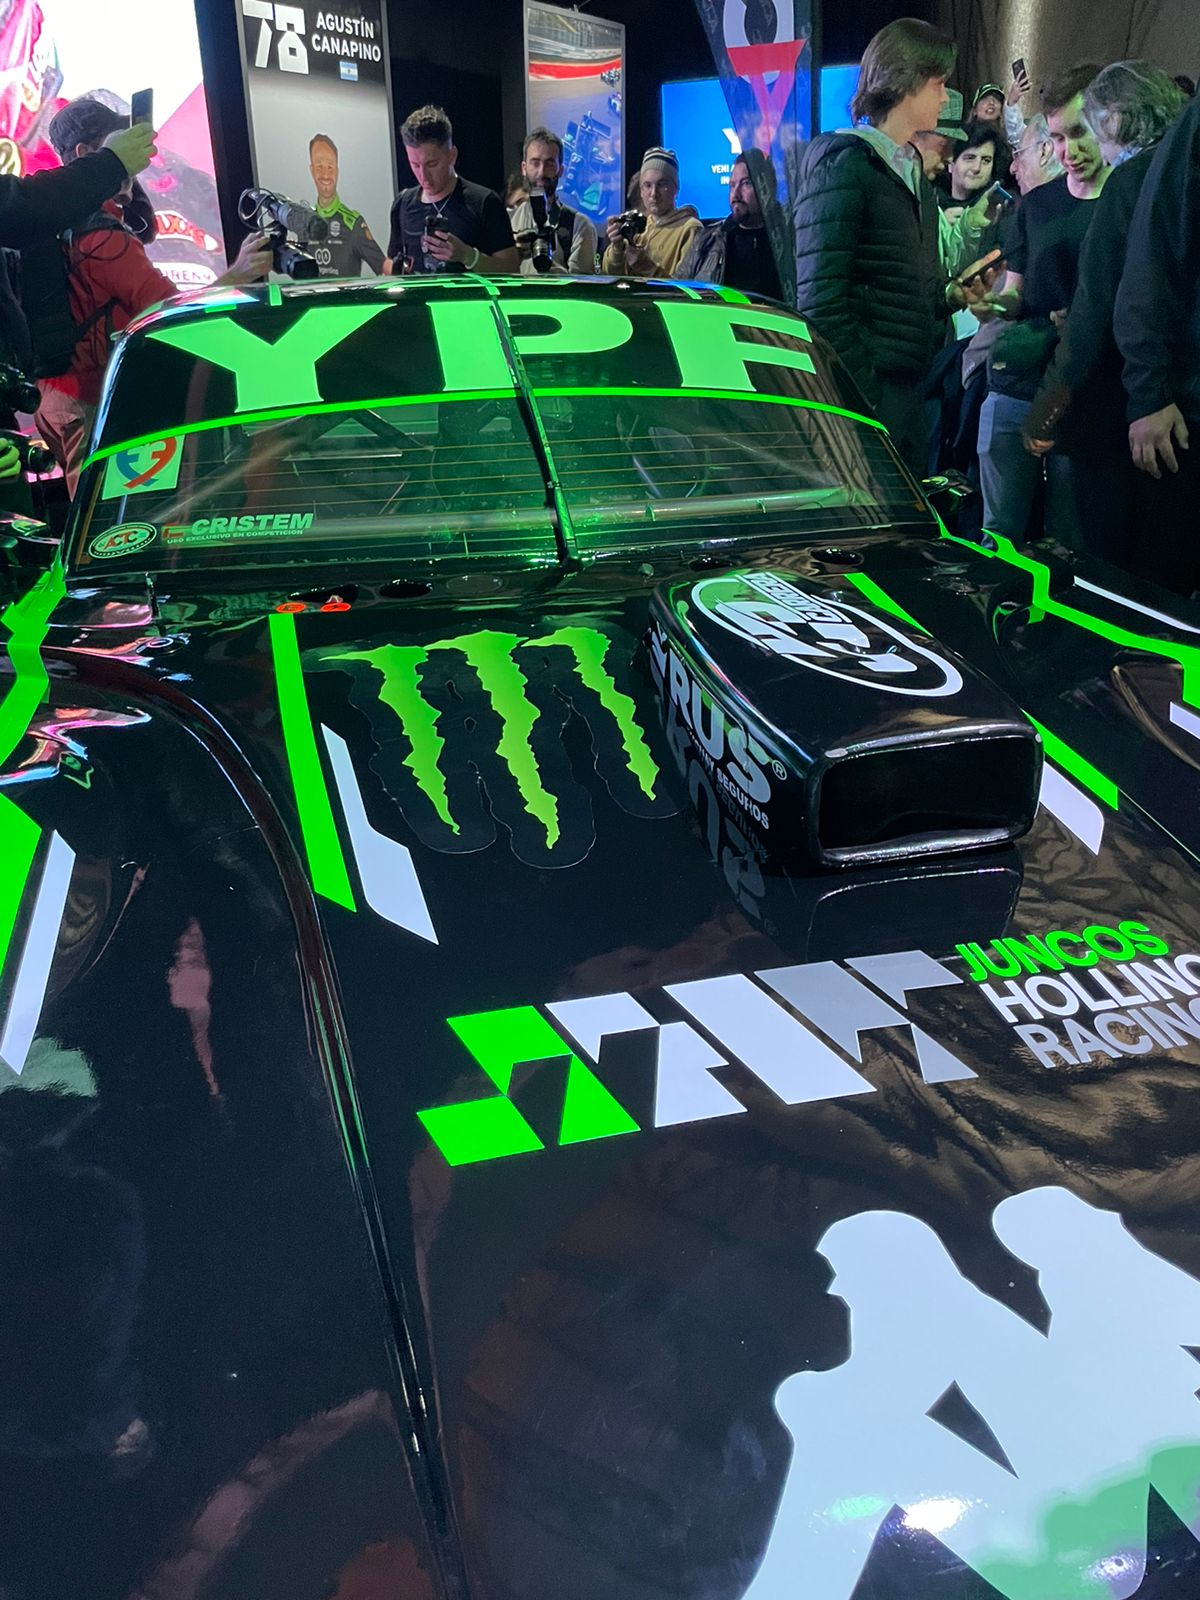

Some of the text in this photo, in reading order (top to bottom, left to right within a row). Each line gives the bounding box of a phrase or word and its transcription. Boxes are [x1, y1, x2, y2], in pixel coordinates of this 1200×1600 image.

[242, 0, 309, 74] 78
[311, 34, 382, 62] CANAPINO
[316, 11, 375, 39] AGUSTÍN
[145, 300, 817, 413] YPF
[186, 532, 231, 543] EXCLUSIVO
[191, 513, 314, 536] CRISTEM
[716, 767, 770, 831] SEGUROS
[955, 920, 1169, 982] JUNCOS
[1013, 997, 1200, 1069] RACIN
